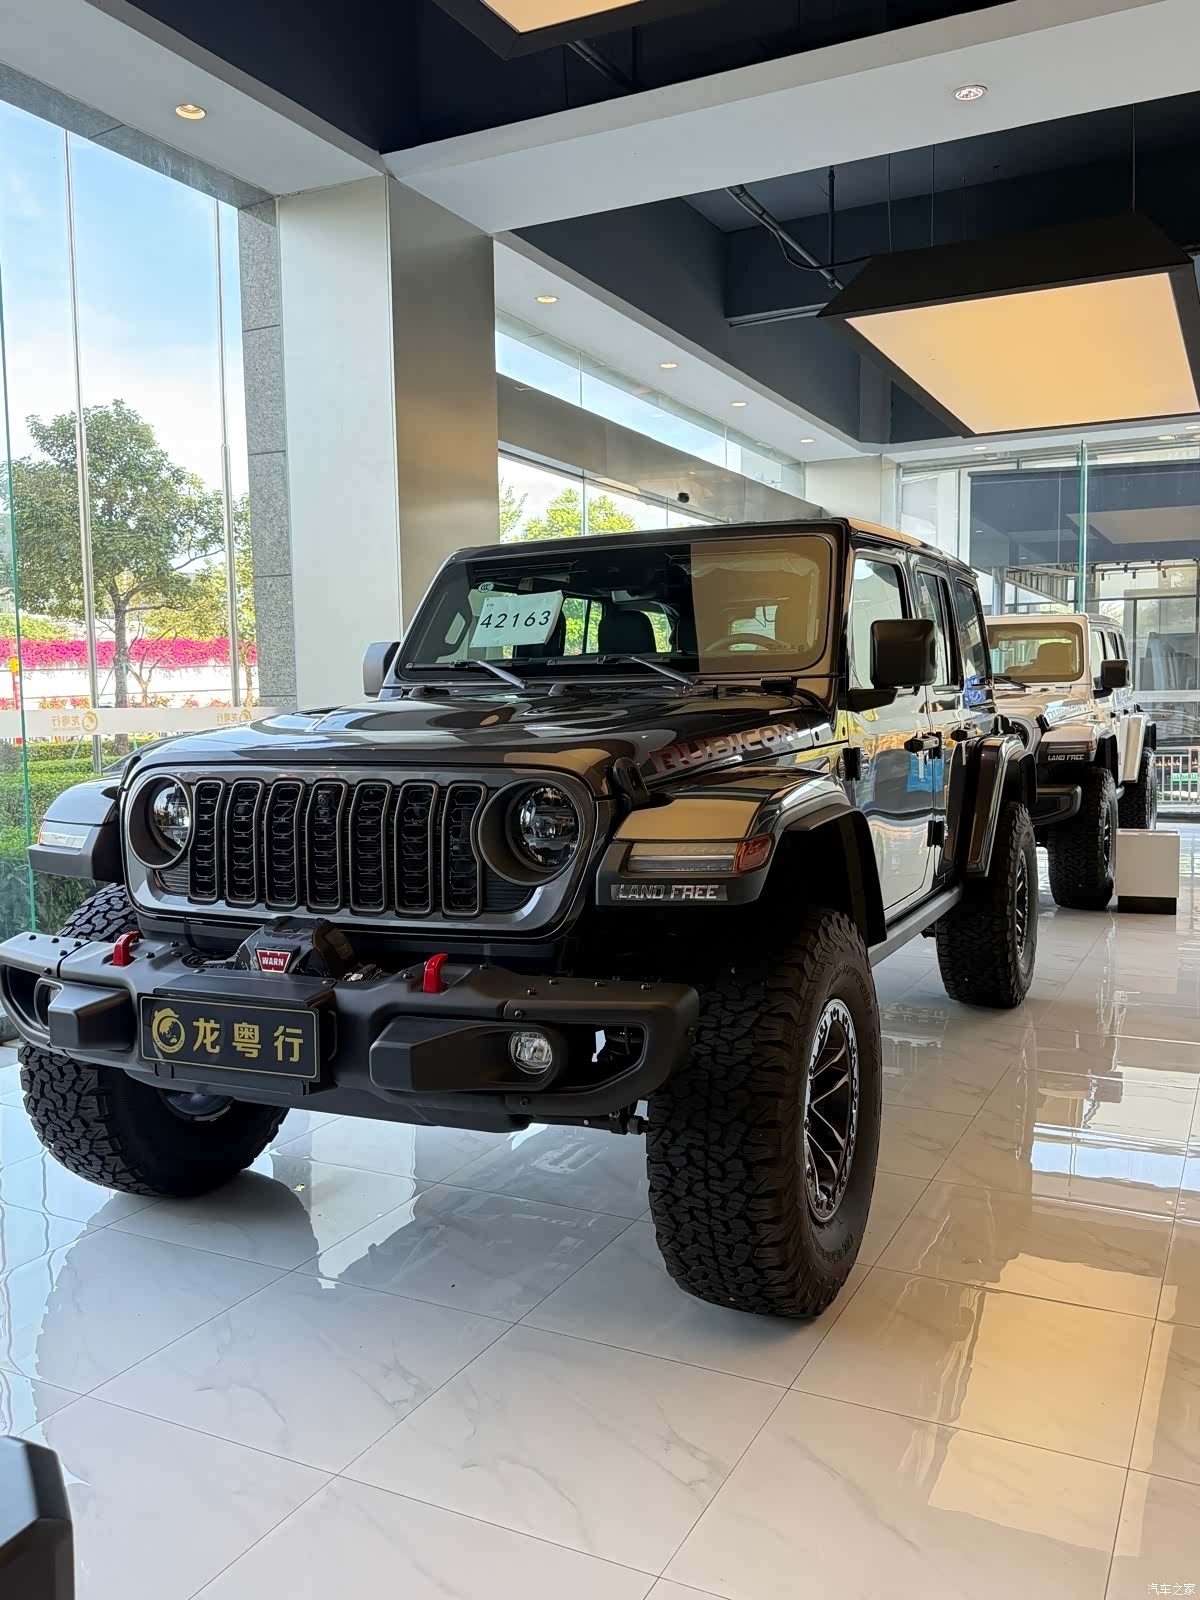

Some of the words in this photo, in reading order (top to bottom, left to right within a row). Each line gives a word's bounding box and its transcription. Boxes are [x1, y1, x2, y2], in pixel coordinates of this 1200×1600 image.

[480, 610, 551, 629] 42163
[648, 721, 798, 774] RUBICON
[619, 884, 666, 899] LAND
[670, 884, 719, 899] FREE
[262, 956, 284, 967] WARN
[192, 1017, 304, 1063] 龙粤行
